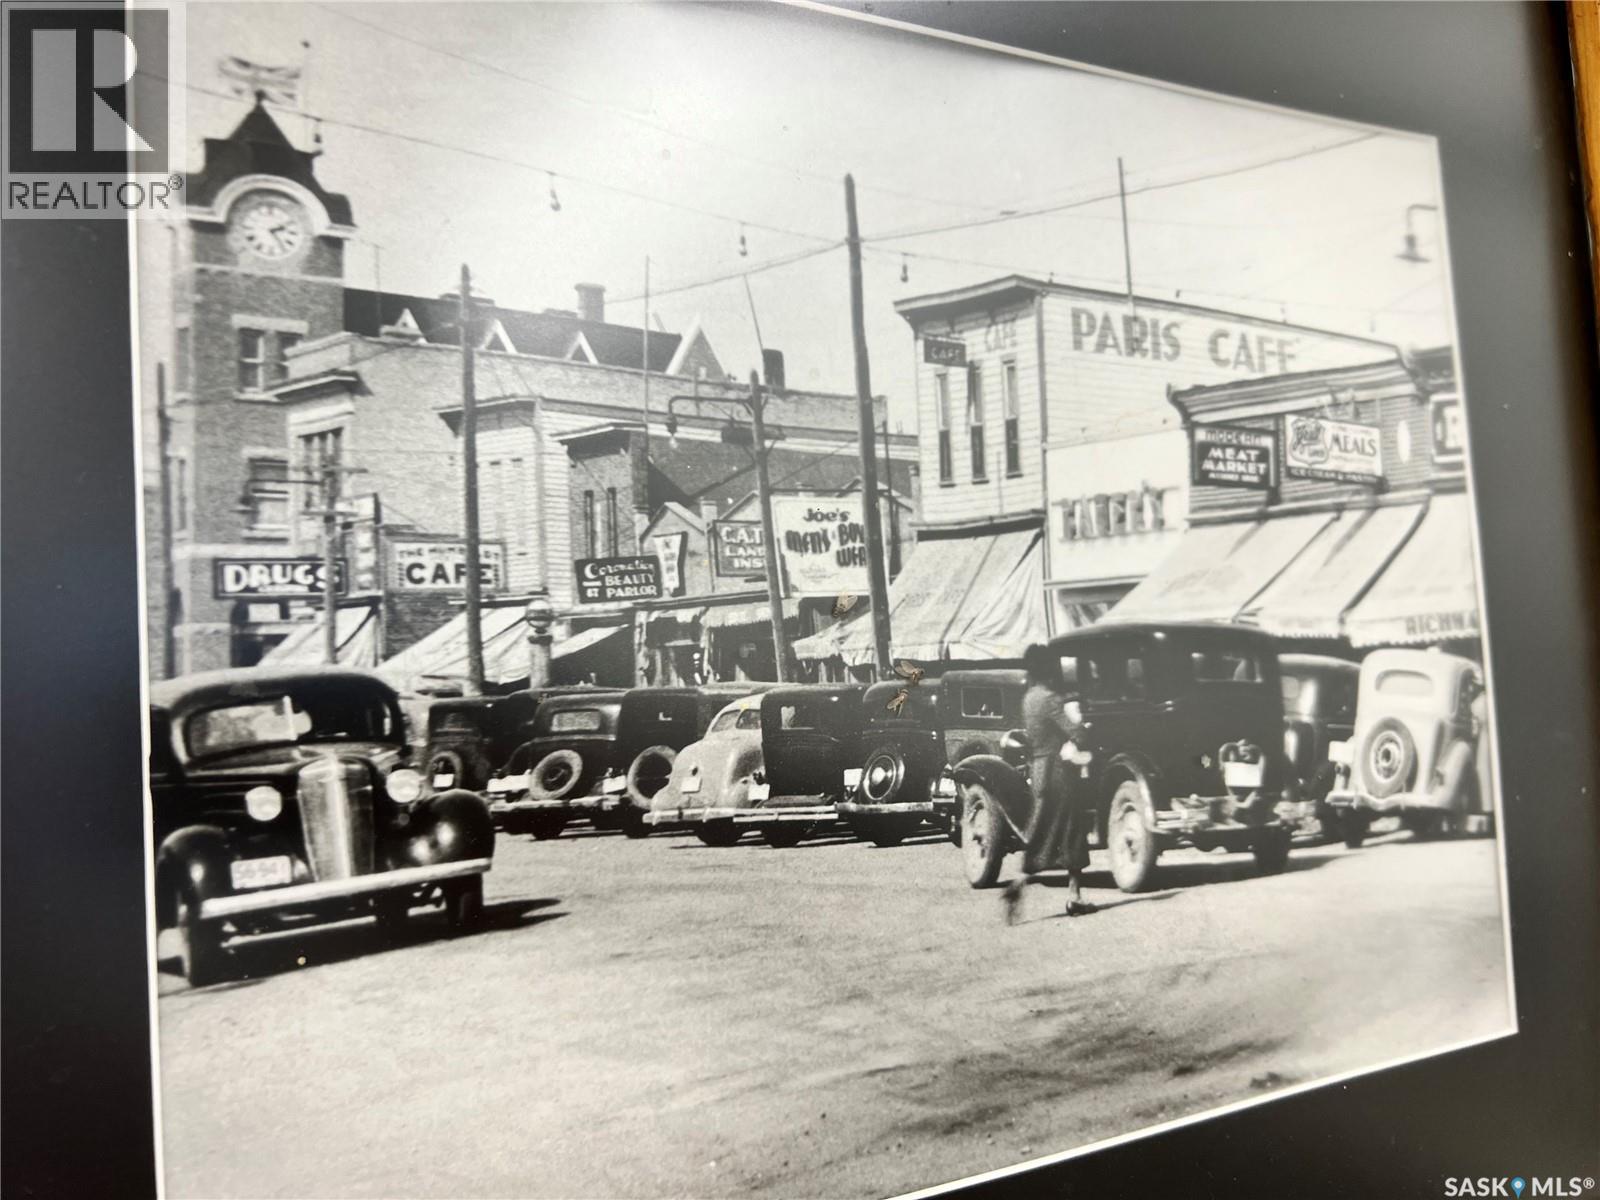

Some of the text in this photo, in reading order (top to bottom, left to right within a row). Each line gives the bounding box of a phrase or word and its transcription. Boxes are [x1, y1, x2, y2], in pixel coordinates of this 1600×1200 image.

[1071, 307, 1181, 362] PARIS
[1329, 431, 1377, 457] MEALS
[1208, 447, 1260, 462] MEAT
[1201, 459, 1267, 475] MARKET
[803, 508, 850, 522] Joe's
[836, 545, 867, 568] WEA
[223, 564, 340, 593] DRUGS
[406, 562, 492, 585] CAFE
[605, 573, 655, 587] BEAUTY
[606, 585, 657, 598] PARLOR
